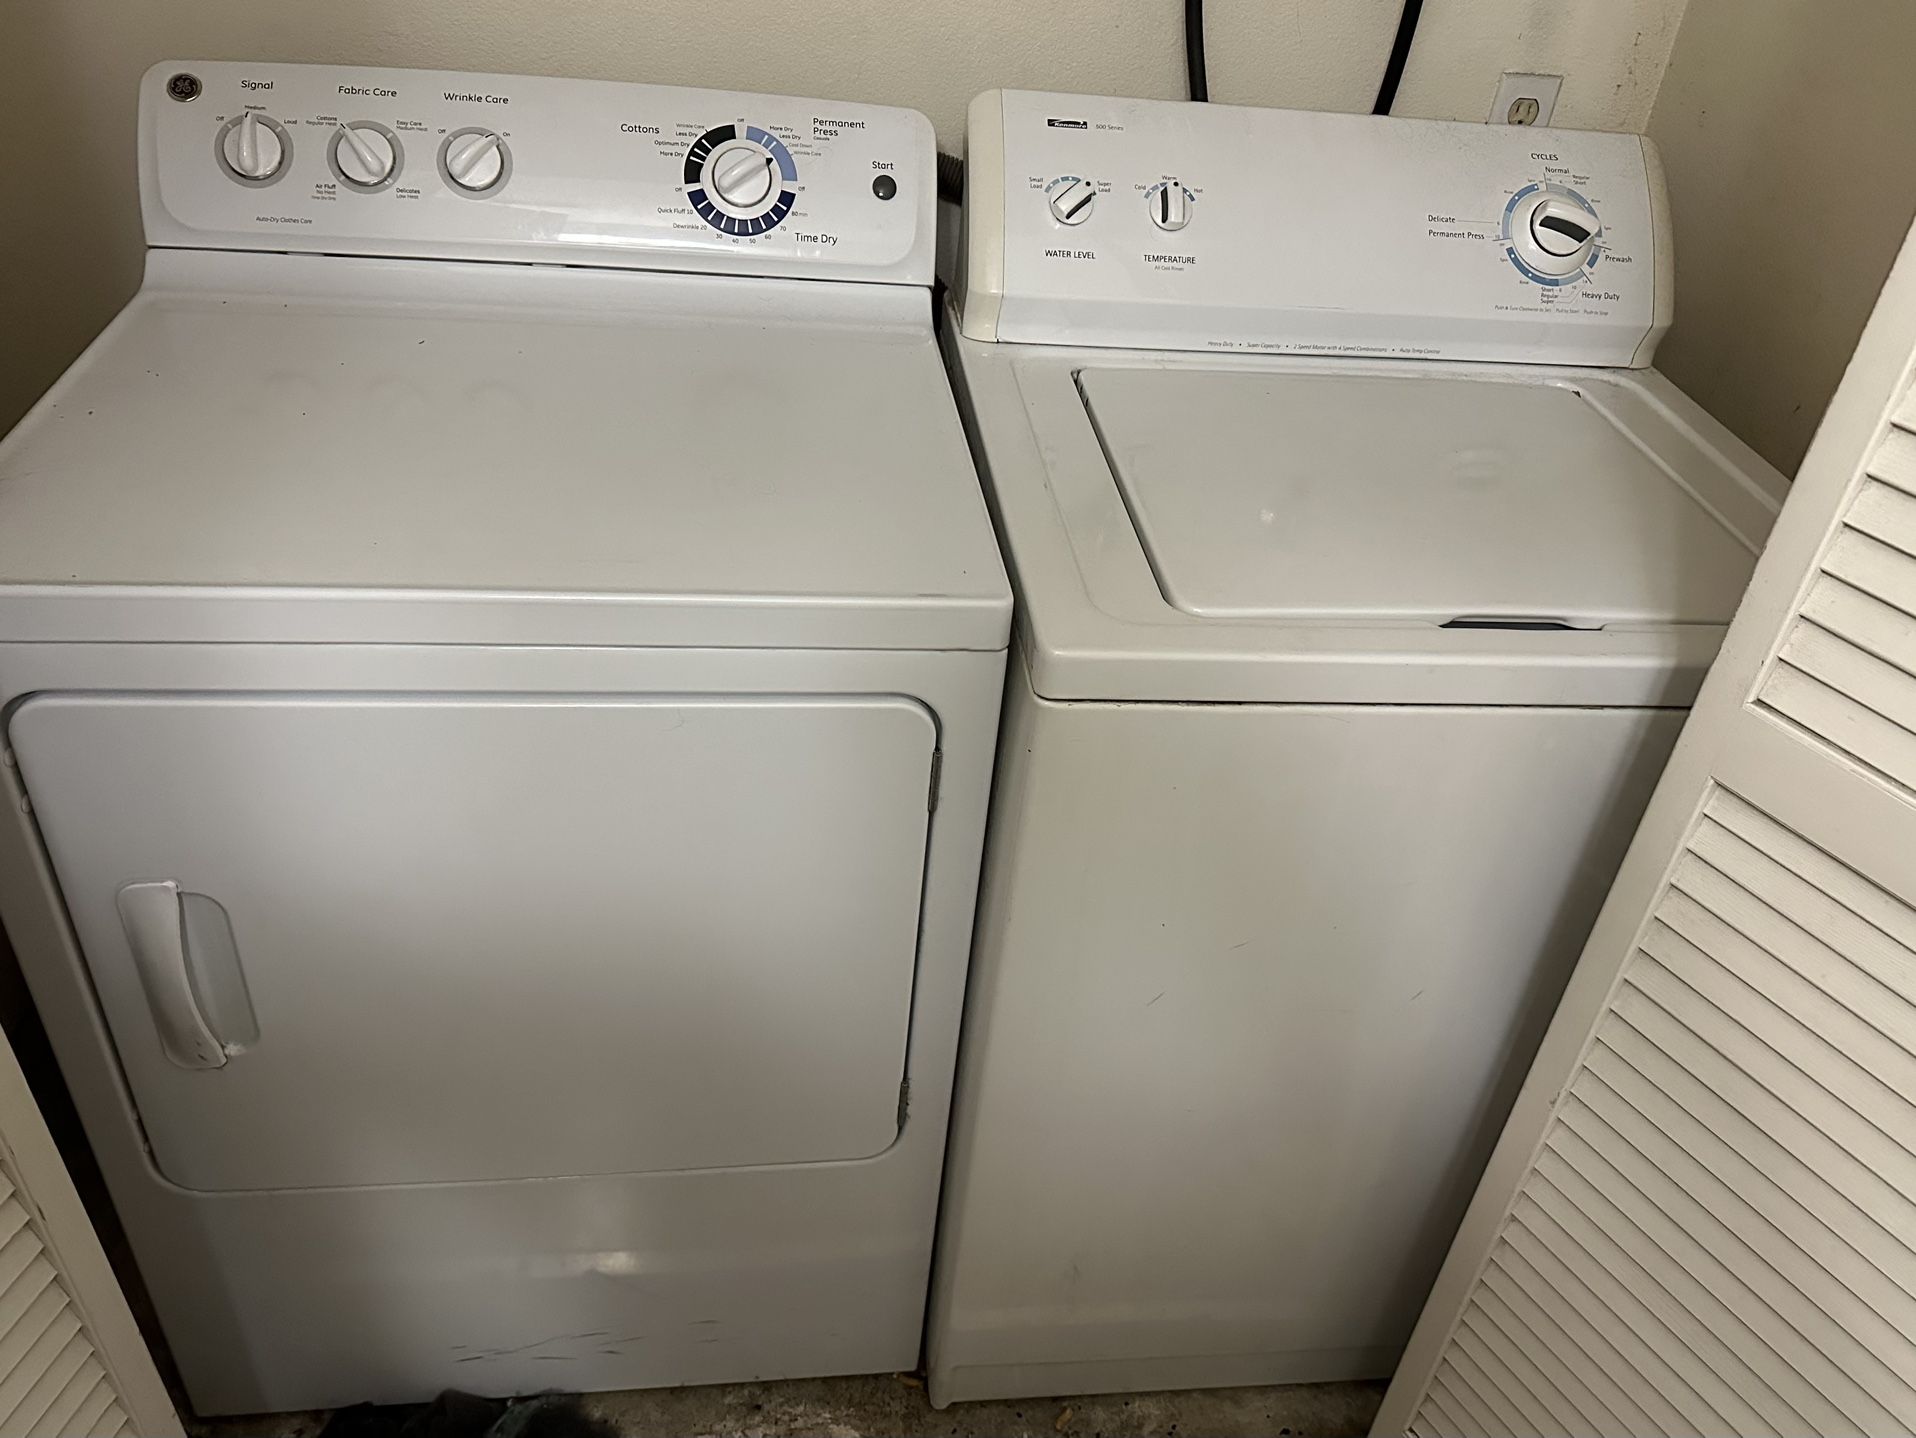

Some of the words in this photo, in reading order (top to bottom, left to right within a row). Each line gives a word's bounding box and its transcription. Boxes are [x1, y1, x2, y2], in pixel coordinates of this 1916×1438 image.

[241, 80, 273, 90] Signal
[338, 86, 371, 96] Fabric
[373, 88, 398, 97] Care
[444, 92, 483, 103] Wrinkle
[485, 94, 509, 104] Care
[813, 117, 866, 129] Permanent
[620, 123, 660, 134] Cottons
[813, 127, 839, 136] Press
[1531, 152, 1558, 161] CYCLES
[872, 160, 894, 170] Start
[1545, 166, 1569, 174] Normal
[657, 207, 673, 215] Quick
[673, 207, 686, 215] Fluff
[1428, 214, 1455, 223] Delicate
[672, 222, 699, 230] Dewrinkle
[795, 233, 818, 243] Time
[820, 234, 838, 246] Dry
[1428, 229, 1465, 238] Permanent
[1467, 231, 1485, 240] Press
[1045, 249, 1072, 258] WATER
[1073, 251, 1096, 260] LEVEL
[1143, 254, 1196, 264] TEMPERATURE
[1605, 255, 1632, 263] Prewash
[1582, 291, 1602, 300] Heavy
[1603, 292, 1620, 301] Duty
